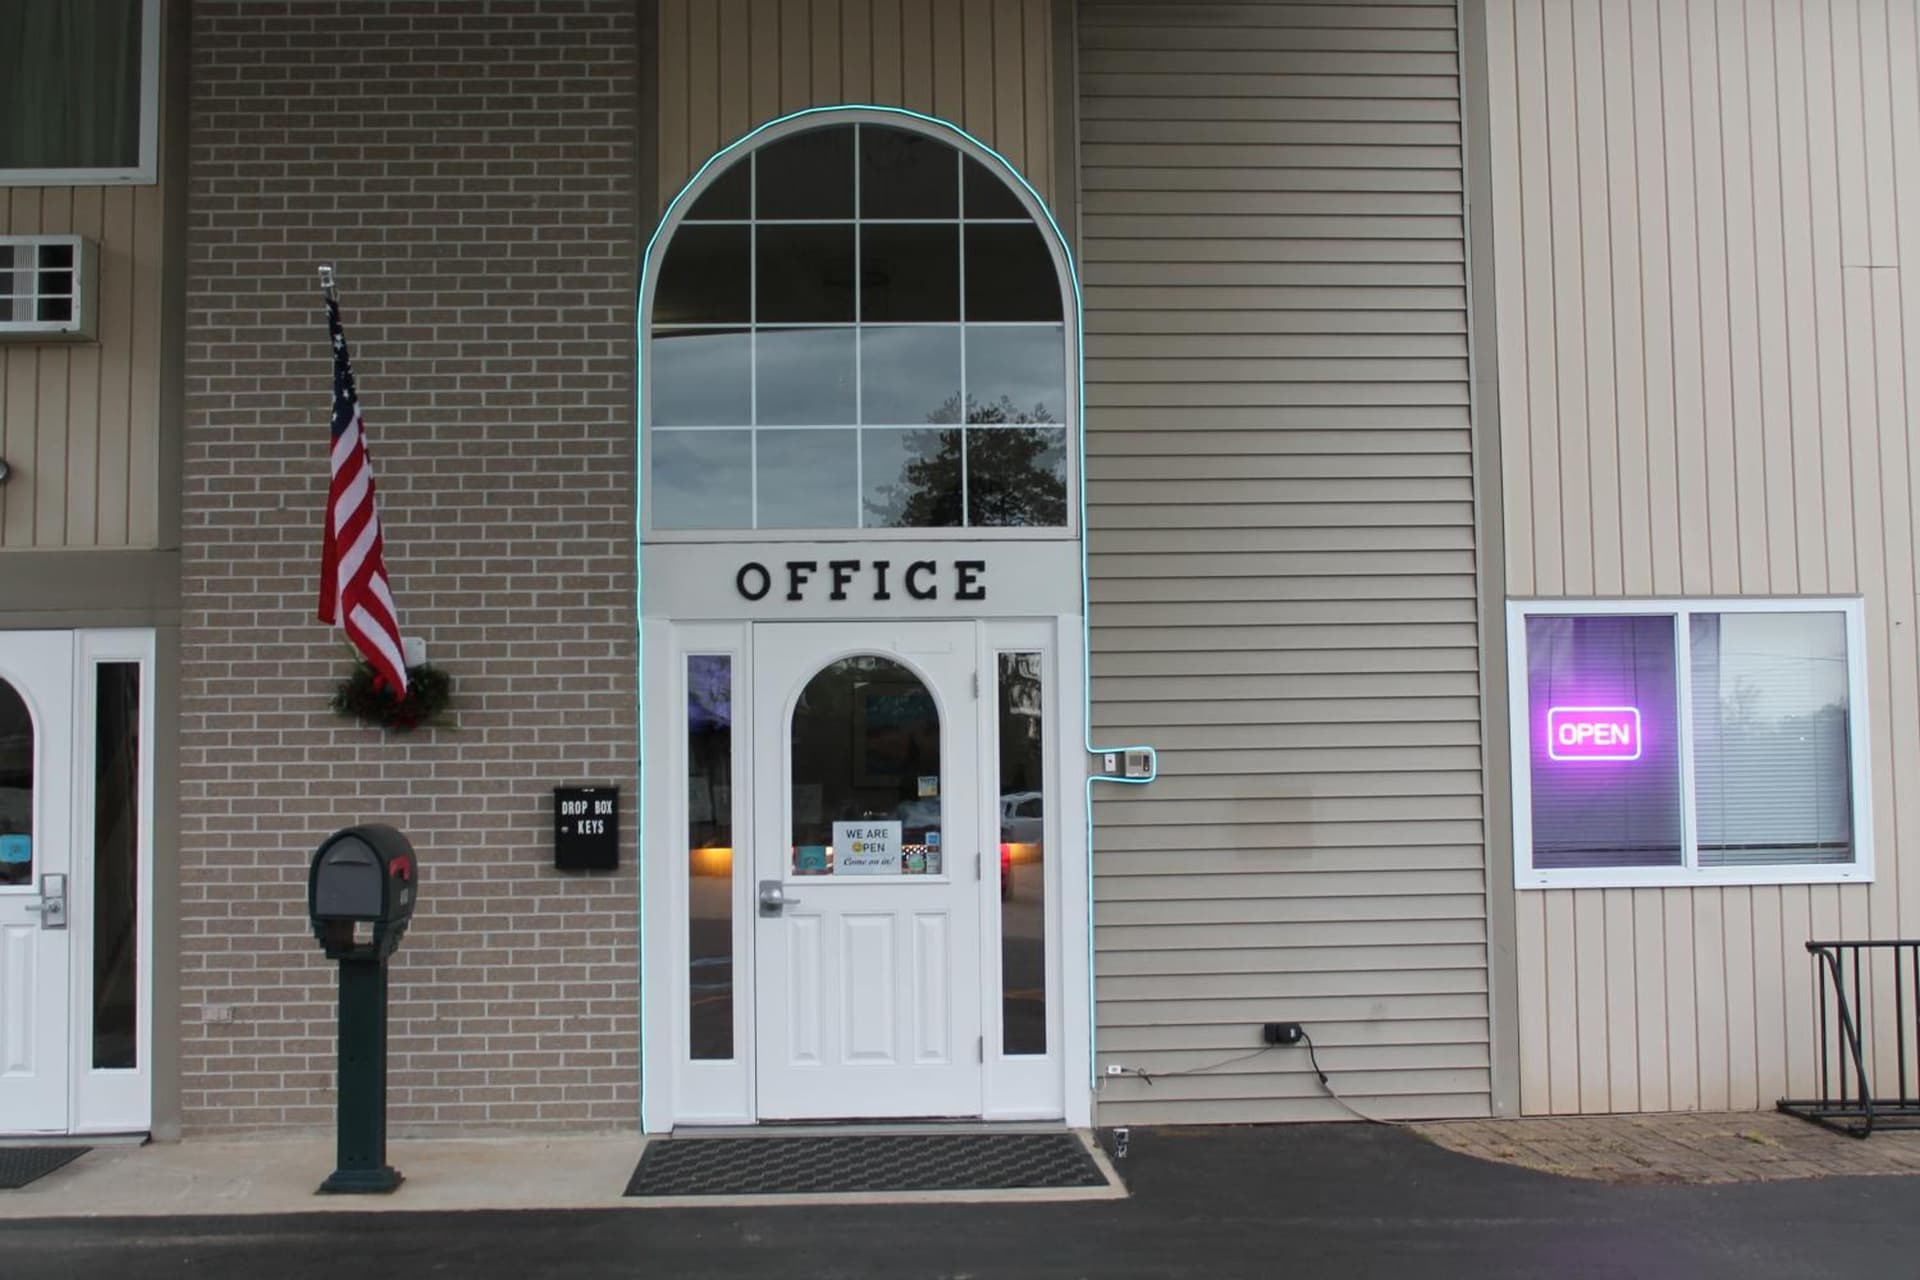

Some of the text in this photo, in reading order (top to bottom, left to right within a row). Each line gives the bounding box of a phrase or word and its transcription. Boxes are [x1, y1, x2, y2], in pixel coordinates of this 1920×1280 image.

[736, 560, 986, 601] OFFICE
[1559, 722, 1630, 746] OPEN
[561, 800, 613, 815] DROP BOX
[577, 820, 604, 834] KEYS
[846, 829, 889, 839] WE ARE
